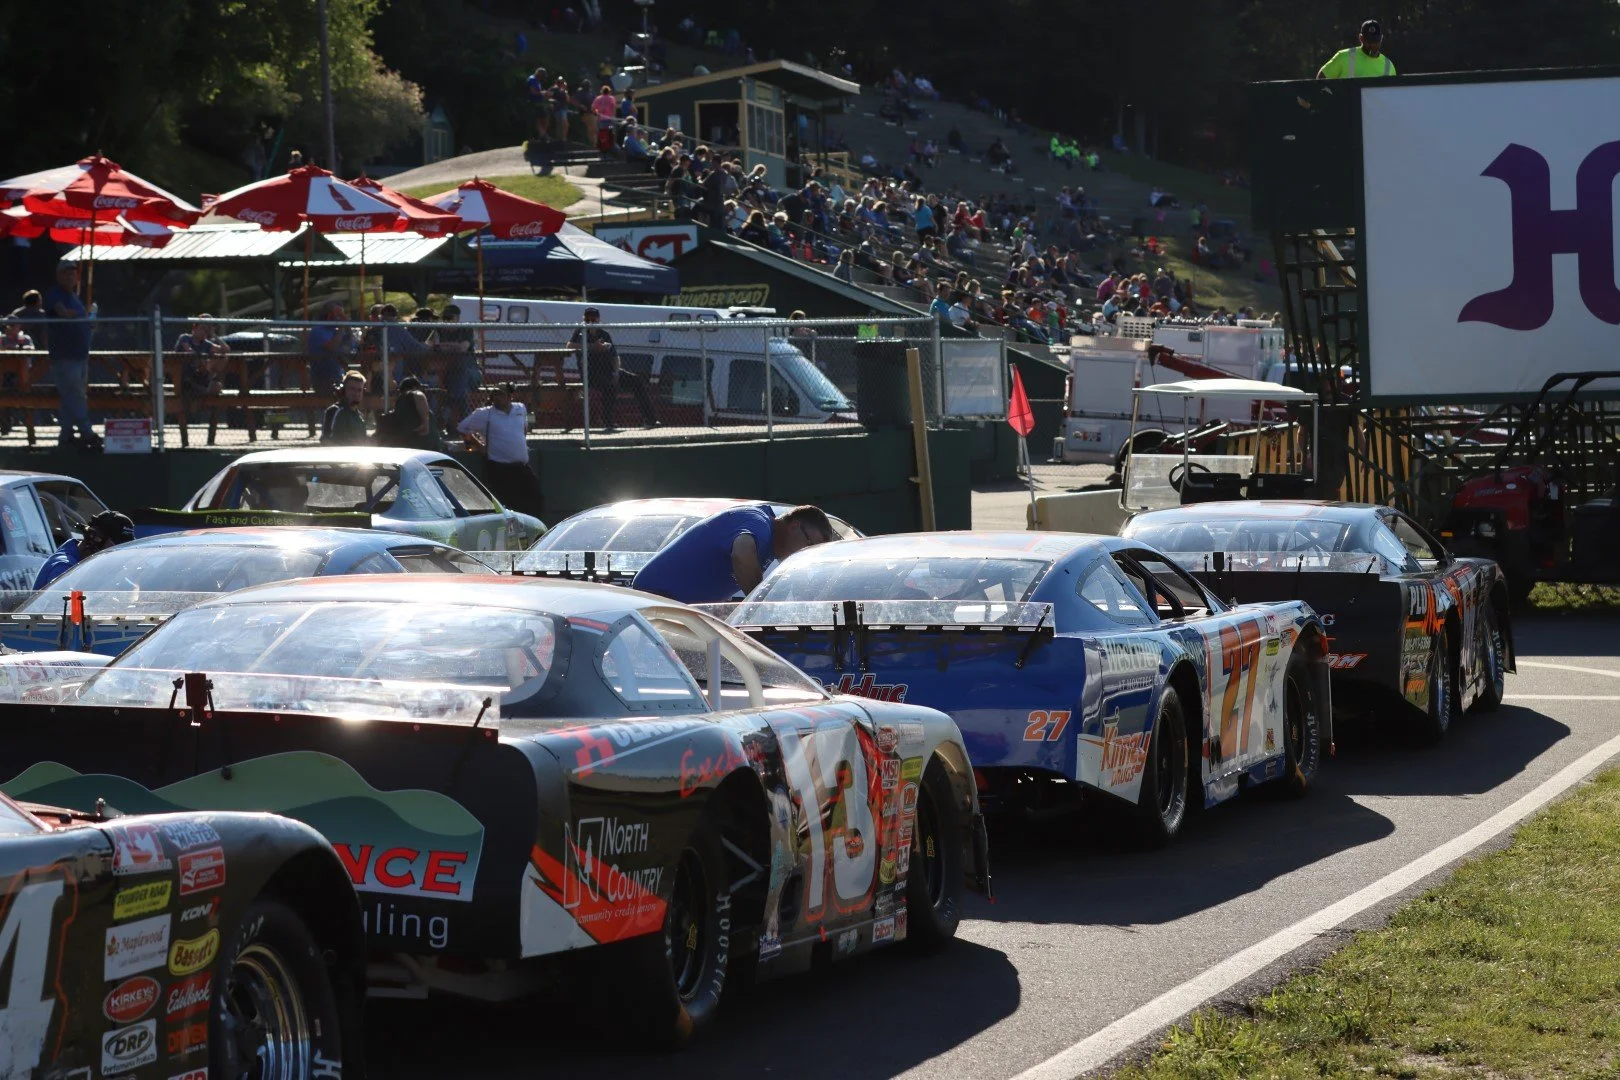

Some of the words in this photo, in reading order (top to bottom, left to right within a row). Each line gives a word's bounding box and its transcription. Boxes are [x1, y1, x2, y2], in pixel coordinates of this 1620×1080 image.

[335, 216, 372, 231] Coca-Cola
[509, 220, 544, 237] Coca-Cola
[727, 289, 760, 304] ROAD
[205, 515, 227, 524] Fast
[229, 516, 248, 525] and
[1022, 710, 1072, 742] 27
[1101, 725, 1152, 774] Kinney
[1110, 766, 1135, 787] DRUGS
[177, 828, 219, 848] MASTER
[614, 905, 636, 918] credit
[636, 902, 657, 914] union
[120, 924, 167, 953] Maplewood
[174, 938, 214, 967] Bassett
[110, 987, 149, 1008] KIRKEY
[166, 980, 210, 1015] Edelbrock
[113, 1030, 149, 1057] DRP
